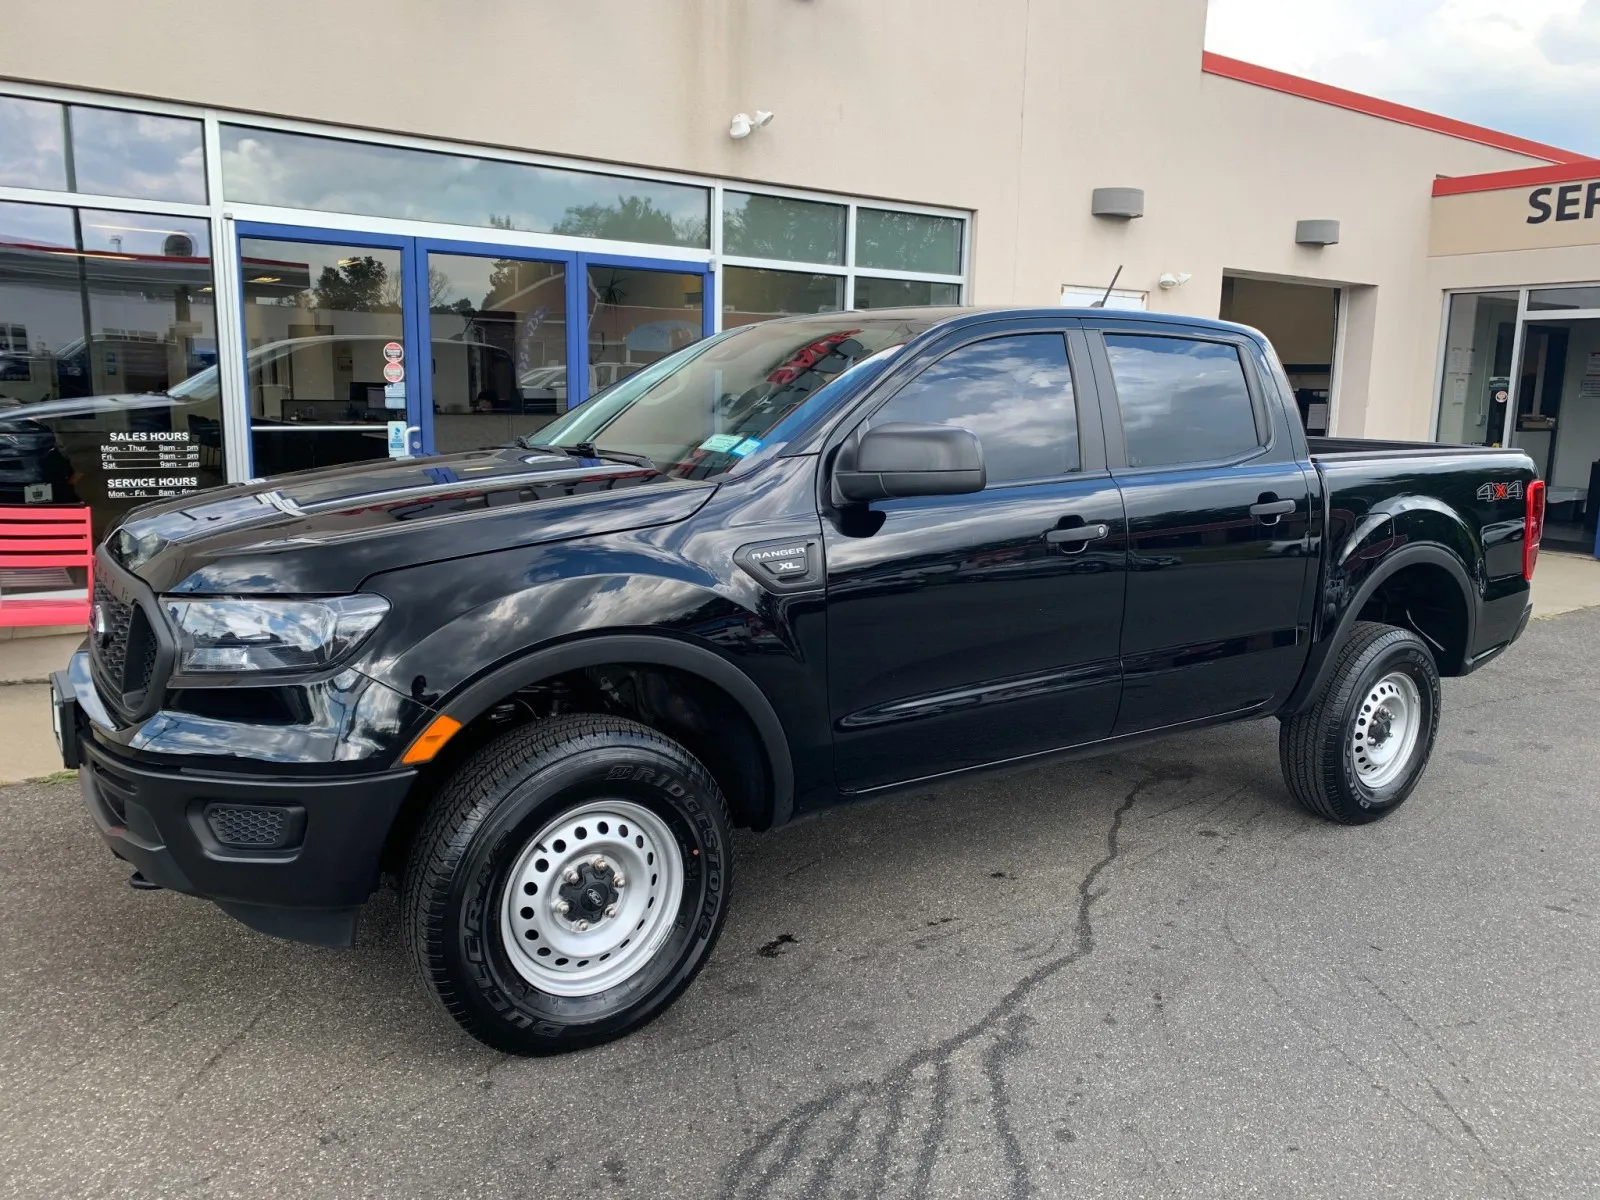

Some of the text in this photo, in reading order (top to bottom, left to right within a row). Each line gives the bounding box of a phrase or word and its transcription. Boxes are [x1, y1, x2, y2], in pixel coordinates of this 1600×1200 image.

[109, 432, 189, 441] SALES HOURS
[128, 444, 147, 452] Thur.
[107, 477, 198, 488] SERVICE HOURS
[107, 490, 128, 498] Mon.
[158, 489, 175, 497] 8am
[751, 547, 805, 560] RANGER
[778, 562, 801, 571] XL
[606, 764, 722, 939] BRIDGESTONE
[462, 897, 566, 1038] DUELER
